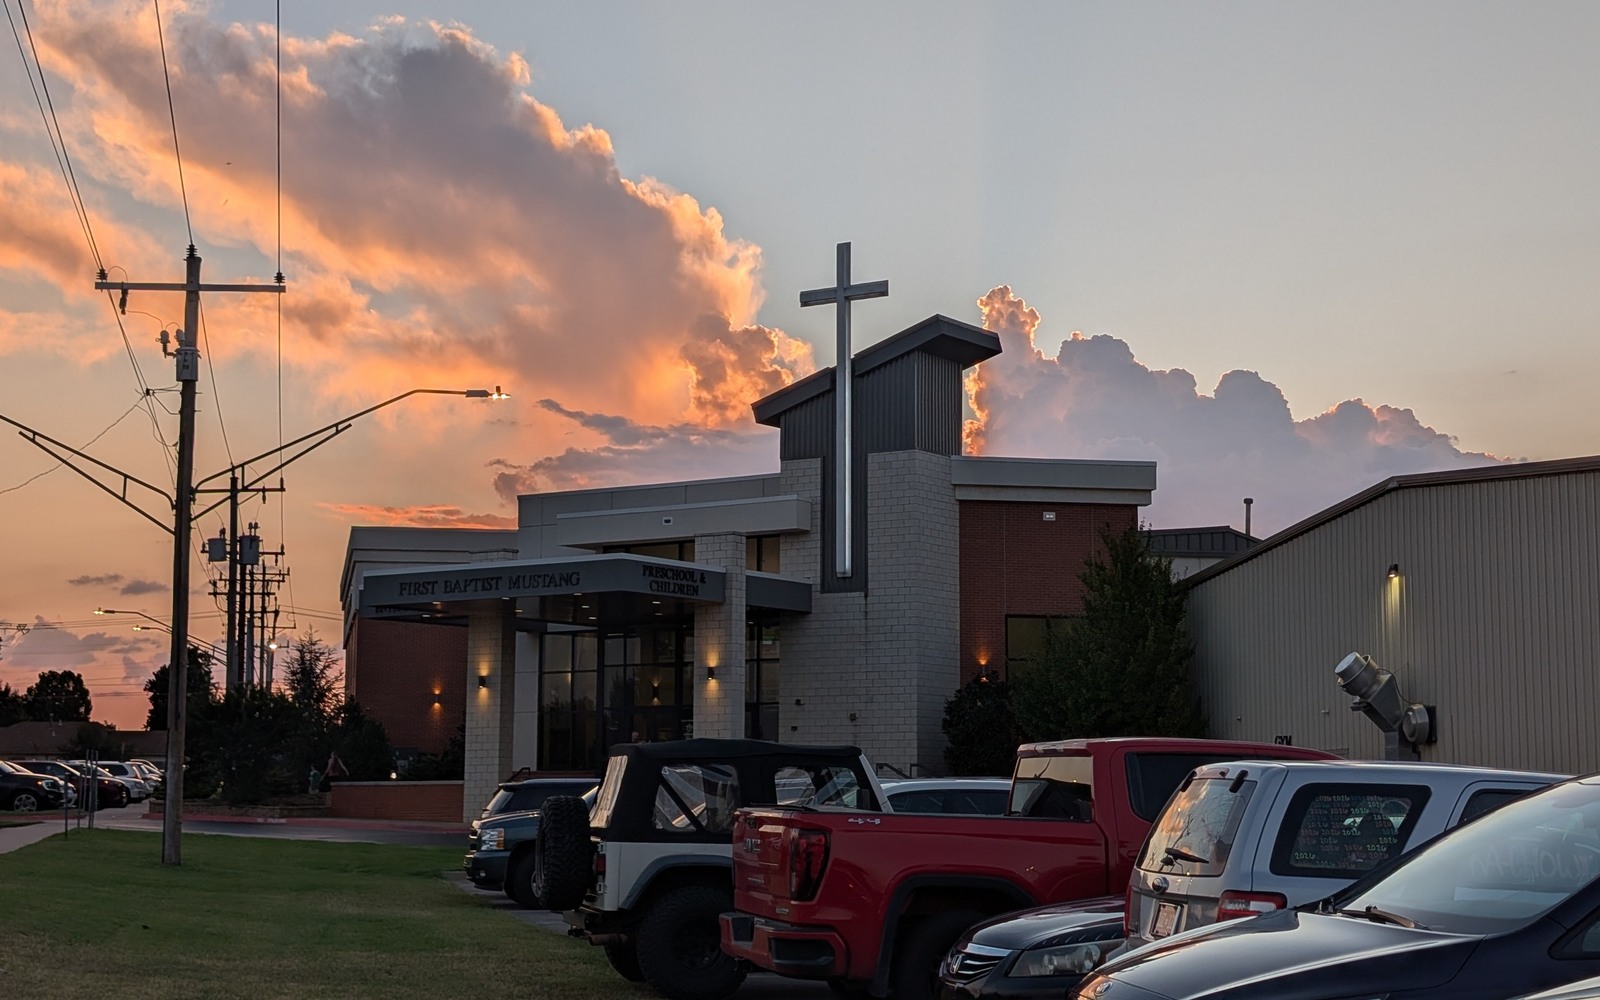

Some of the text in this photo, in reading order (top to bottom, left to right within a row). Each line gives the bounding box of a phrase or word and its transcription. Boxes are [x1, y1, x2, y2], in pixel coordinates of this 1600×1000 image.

[642, 564, 707, 584] PRESCHOOL &
[399, 571, 581, 596] FIRST BAPTIST MUSTANG
[649, 580, 699, 596] CHILDREN
[1275, 735, 1292, 746] GYM
[1366, 844, 1387, 852] 2026
[1294, 852, 1316, 860] 2026
